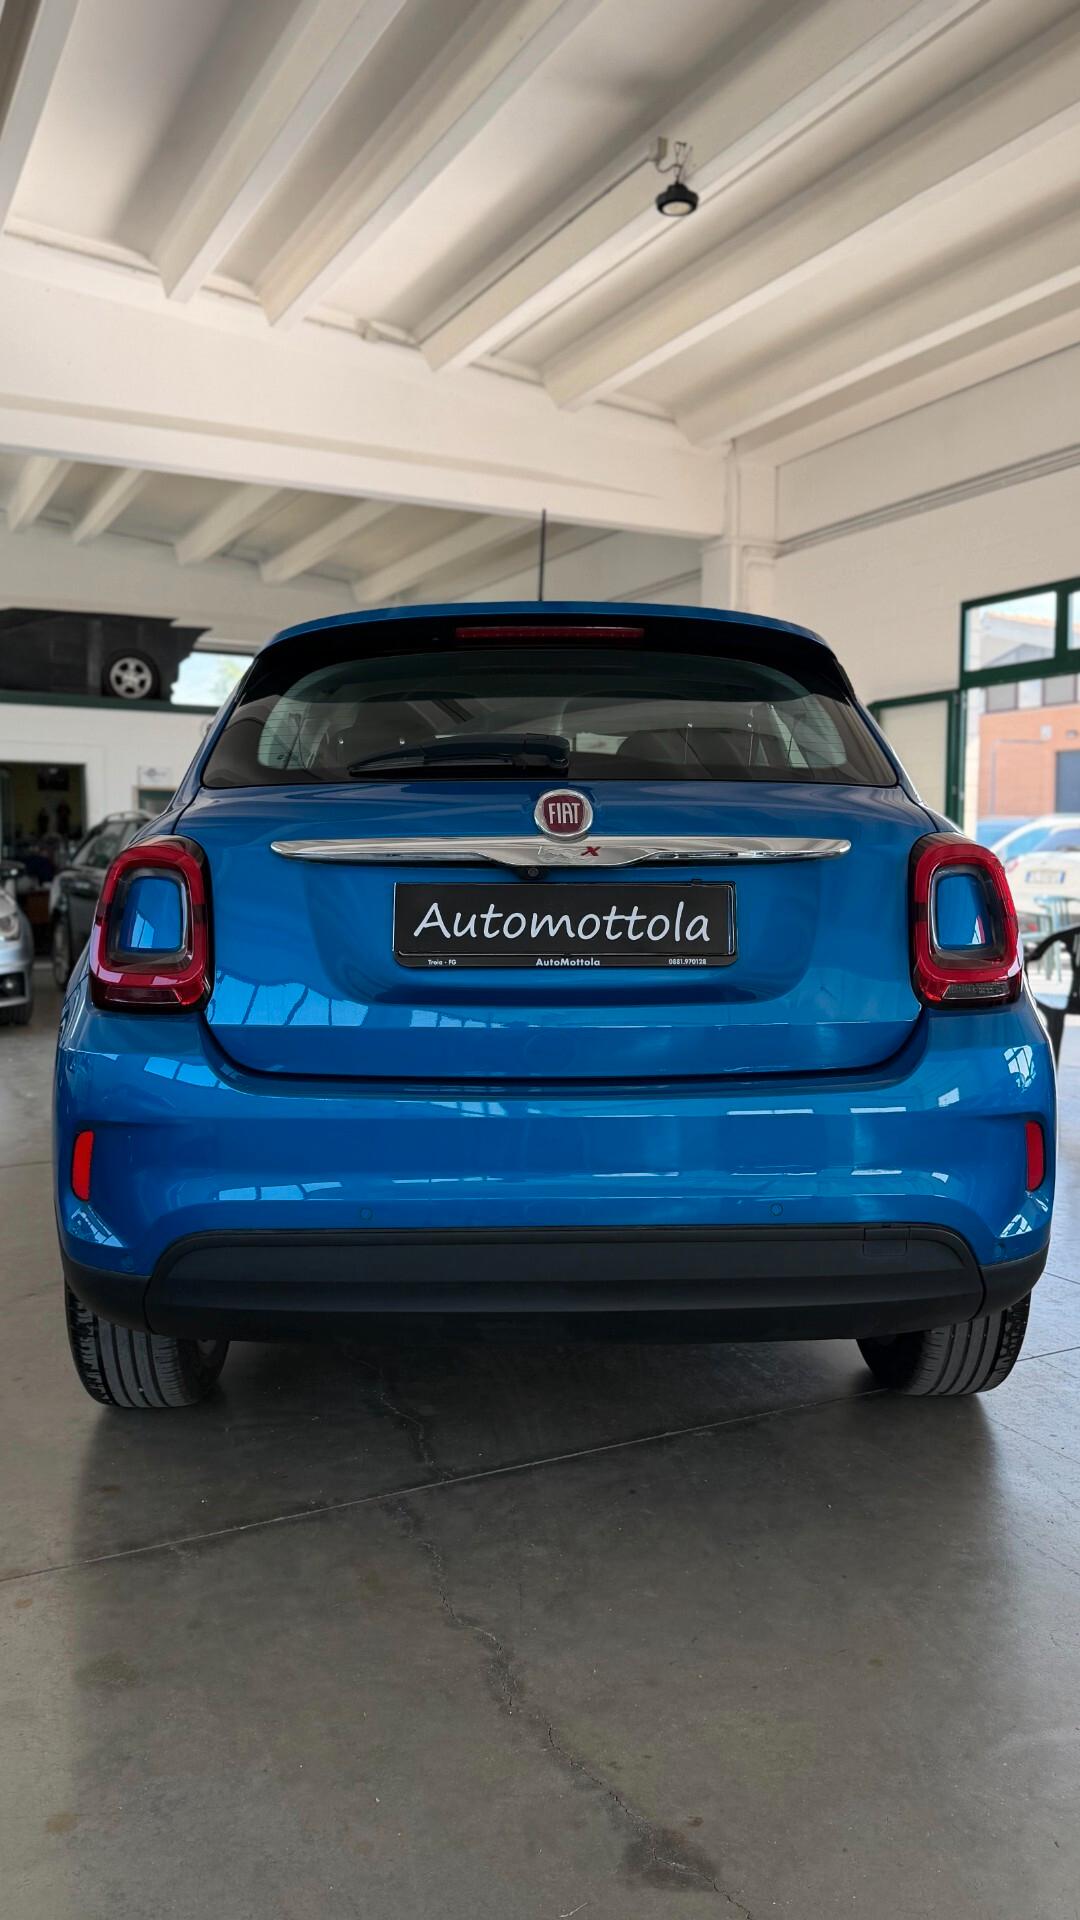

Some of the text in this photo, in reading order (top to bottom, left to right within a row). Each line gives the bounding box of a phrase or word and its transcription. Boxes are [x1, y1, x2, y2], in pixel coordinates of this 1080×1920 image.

[548, 802, 581, 825] FIAT
[413, 901, 711, 943] Automottola
[535, 957, 601, 966] AutoMottola
